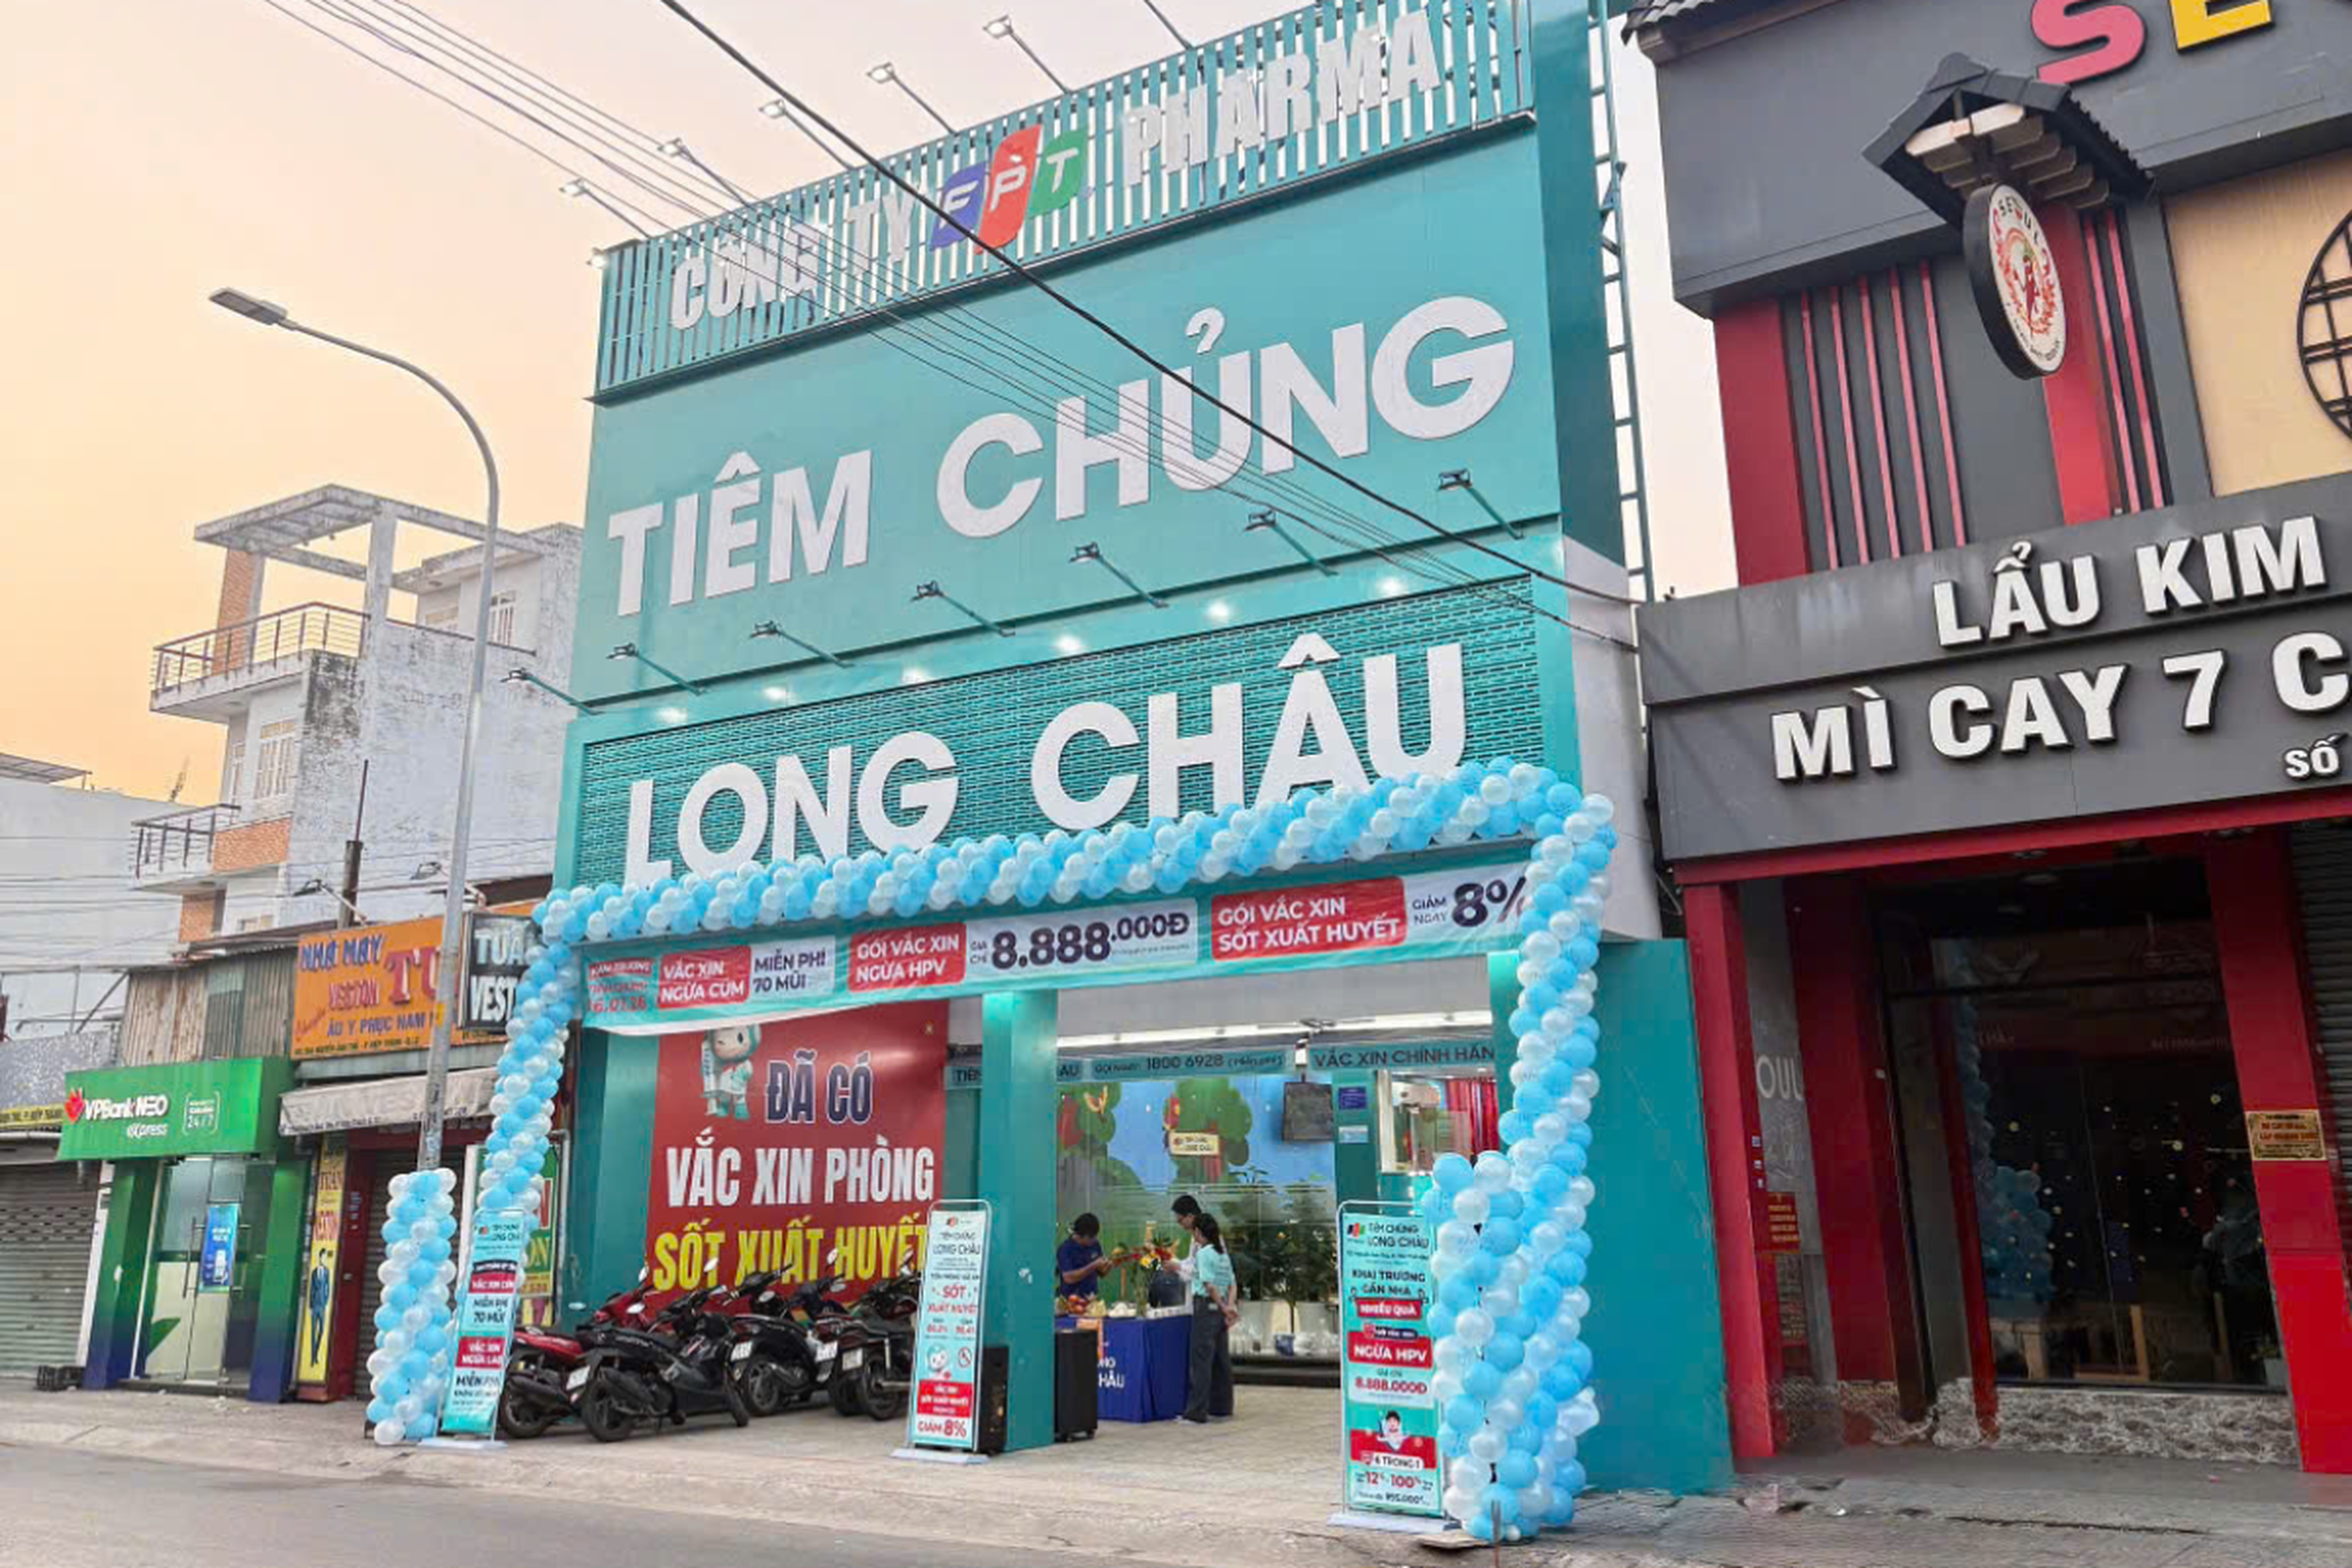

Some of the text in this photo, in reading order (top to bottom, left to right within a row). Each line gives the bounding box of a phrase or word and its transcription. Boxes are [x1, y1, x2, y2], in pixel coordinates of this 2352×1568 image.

[671, 8, 1442, 331] CÔNG TY FPT PHARMA
[607, 295, 1515, 617] TIÊM CHỦNG
[1932, 514, 2327, 648] LẨU KIM
[1770, 687, 1894, 783] MÌ
[1928, 663, 2129, 760] CAY
[2161, 649, 2225, 731] 7
[624, 634, 1467, 890] LONG CHÂU
[1218, 896, 1346, 927] GÓI VẮC XIN
[1412, 893, 1448, 911] GIẢM
[1451, 874, 1529, 928] 8%
[1218, 919, 1260, 953] SỐT
[1263, 919, 1321, 950] XUẤT
[1326, 910, 1400, 943] HUYẾT
[1412, 910, 1449, 926] NGAY
[856, 932, 960, 960] GÓI VẮC XIN
[990, 911, 1191, 970] 8.888.000Đ
[662, 956, 725, 980] VẮC XIN
[753, 947, 826, 973] MIỄN PHÍ
[855, 958, 946, 983] NGỪA HPV
[661, 980, 706, 1003] NGỪA
[708, 979, 745, 998] CÚM
[753, 969, 807, 994] 70 MŨI
[397, 1011, 425, 1030] NAM
[1147, 1057, 1182, 1070] 1800
[1184, 1054, 1224, 1067] 6928
[1313, 1042, 1496, 1068] VẮC XIN CHÍNH HÃN
[764, 1048, 875, 1124] ĐÃ CÓ
[84, 1097, 135, 1121] VPBank
[135, 1093, 168, 1118] NEO
[665, 1126, 935, 1208] VẮC XIN PHÒNG
[653, 1215, 727, 1292] SỐT
[736, 1213, 824, 1287] XUẤT
[1353, 1343, 1428, 1362] NGỪA HPV
[1097, 1370, 1125, 1389] HÂU
[944, 1419, 967, 1438] 8%
